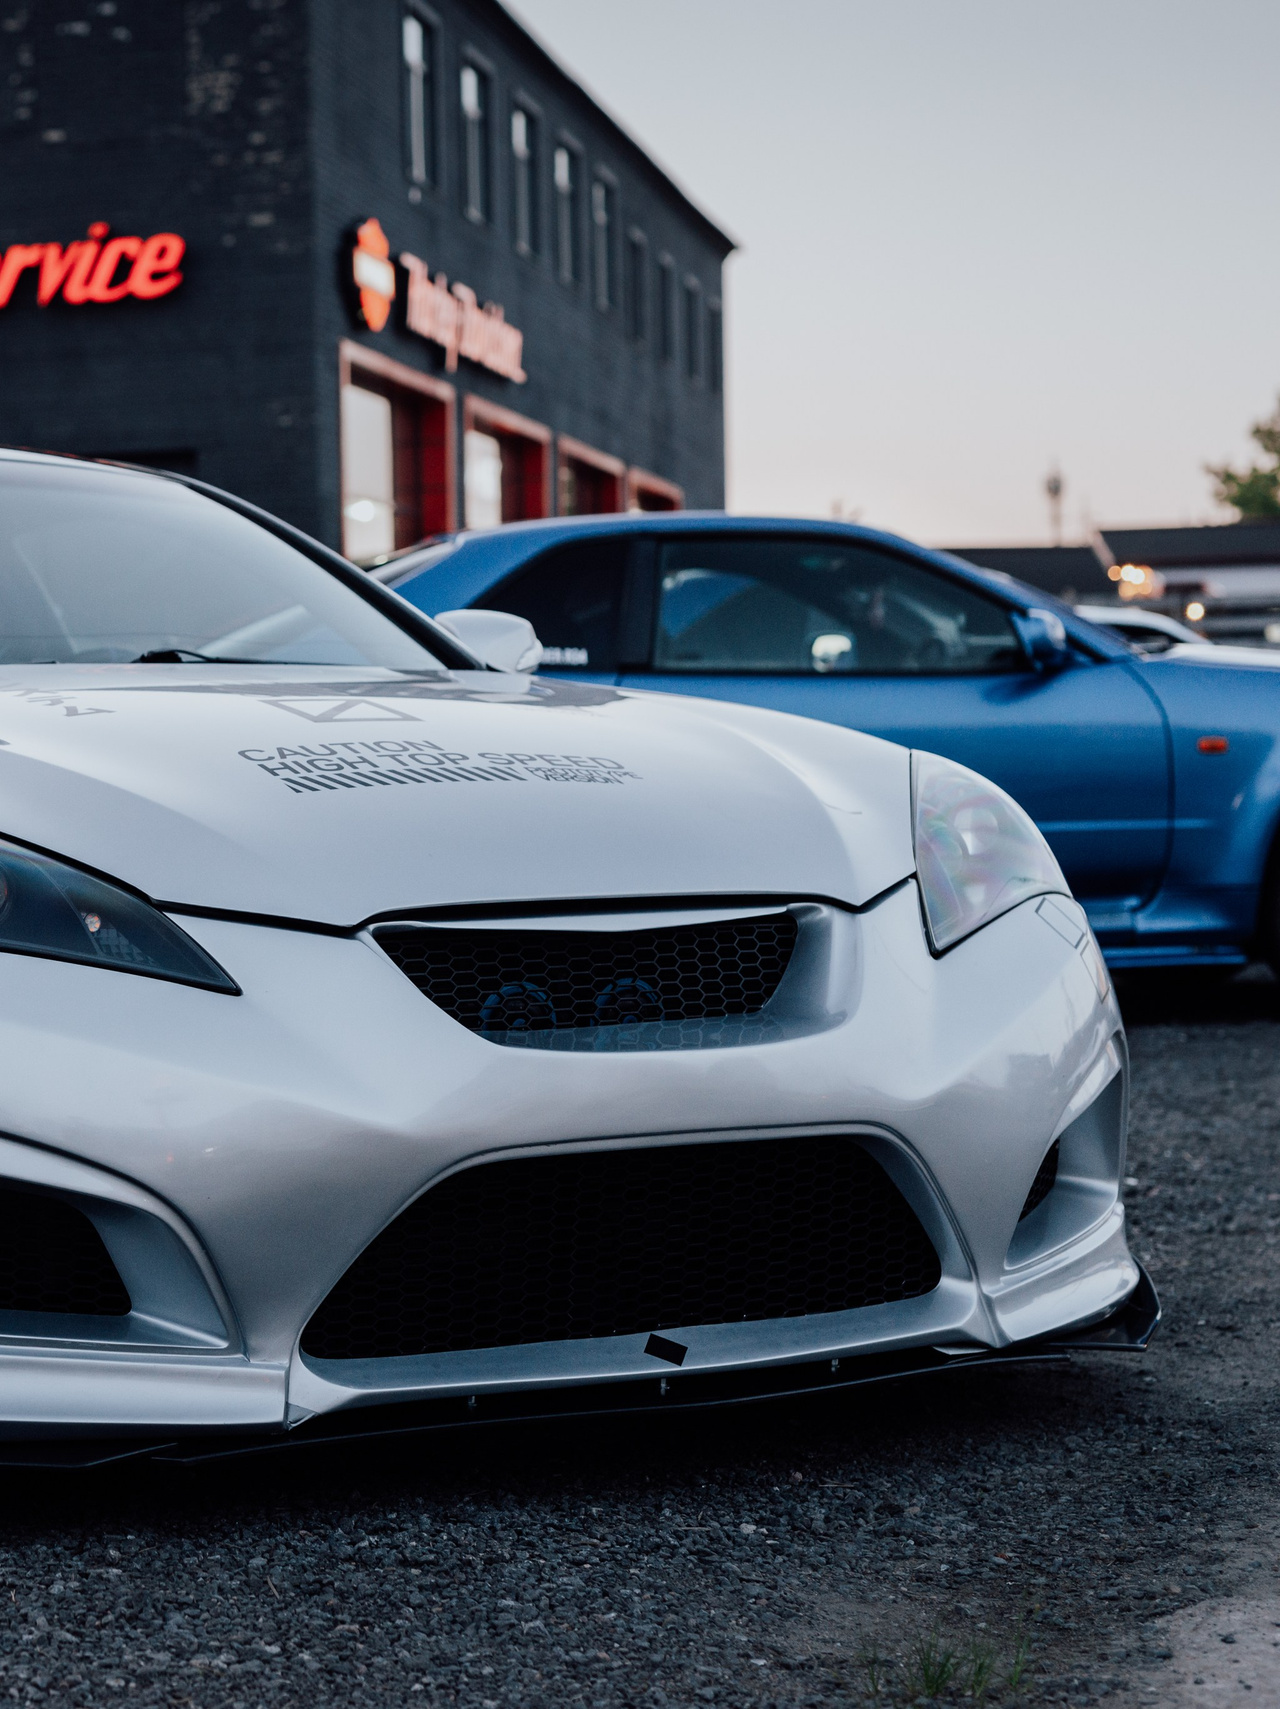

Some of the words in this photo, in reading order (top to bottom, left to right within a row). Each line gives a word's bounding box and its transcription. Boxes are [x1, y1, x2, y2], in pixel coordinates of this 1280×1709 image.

[237, 740, 445, 762] CAUTION
[257, 756, 380, 777] HIGH
[376, 752, 470, 767] TOP
[477, 752, 625, 770] SPEED
